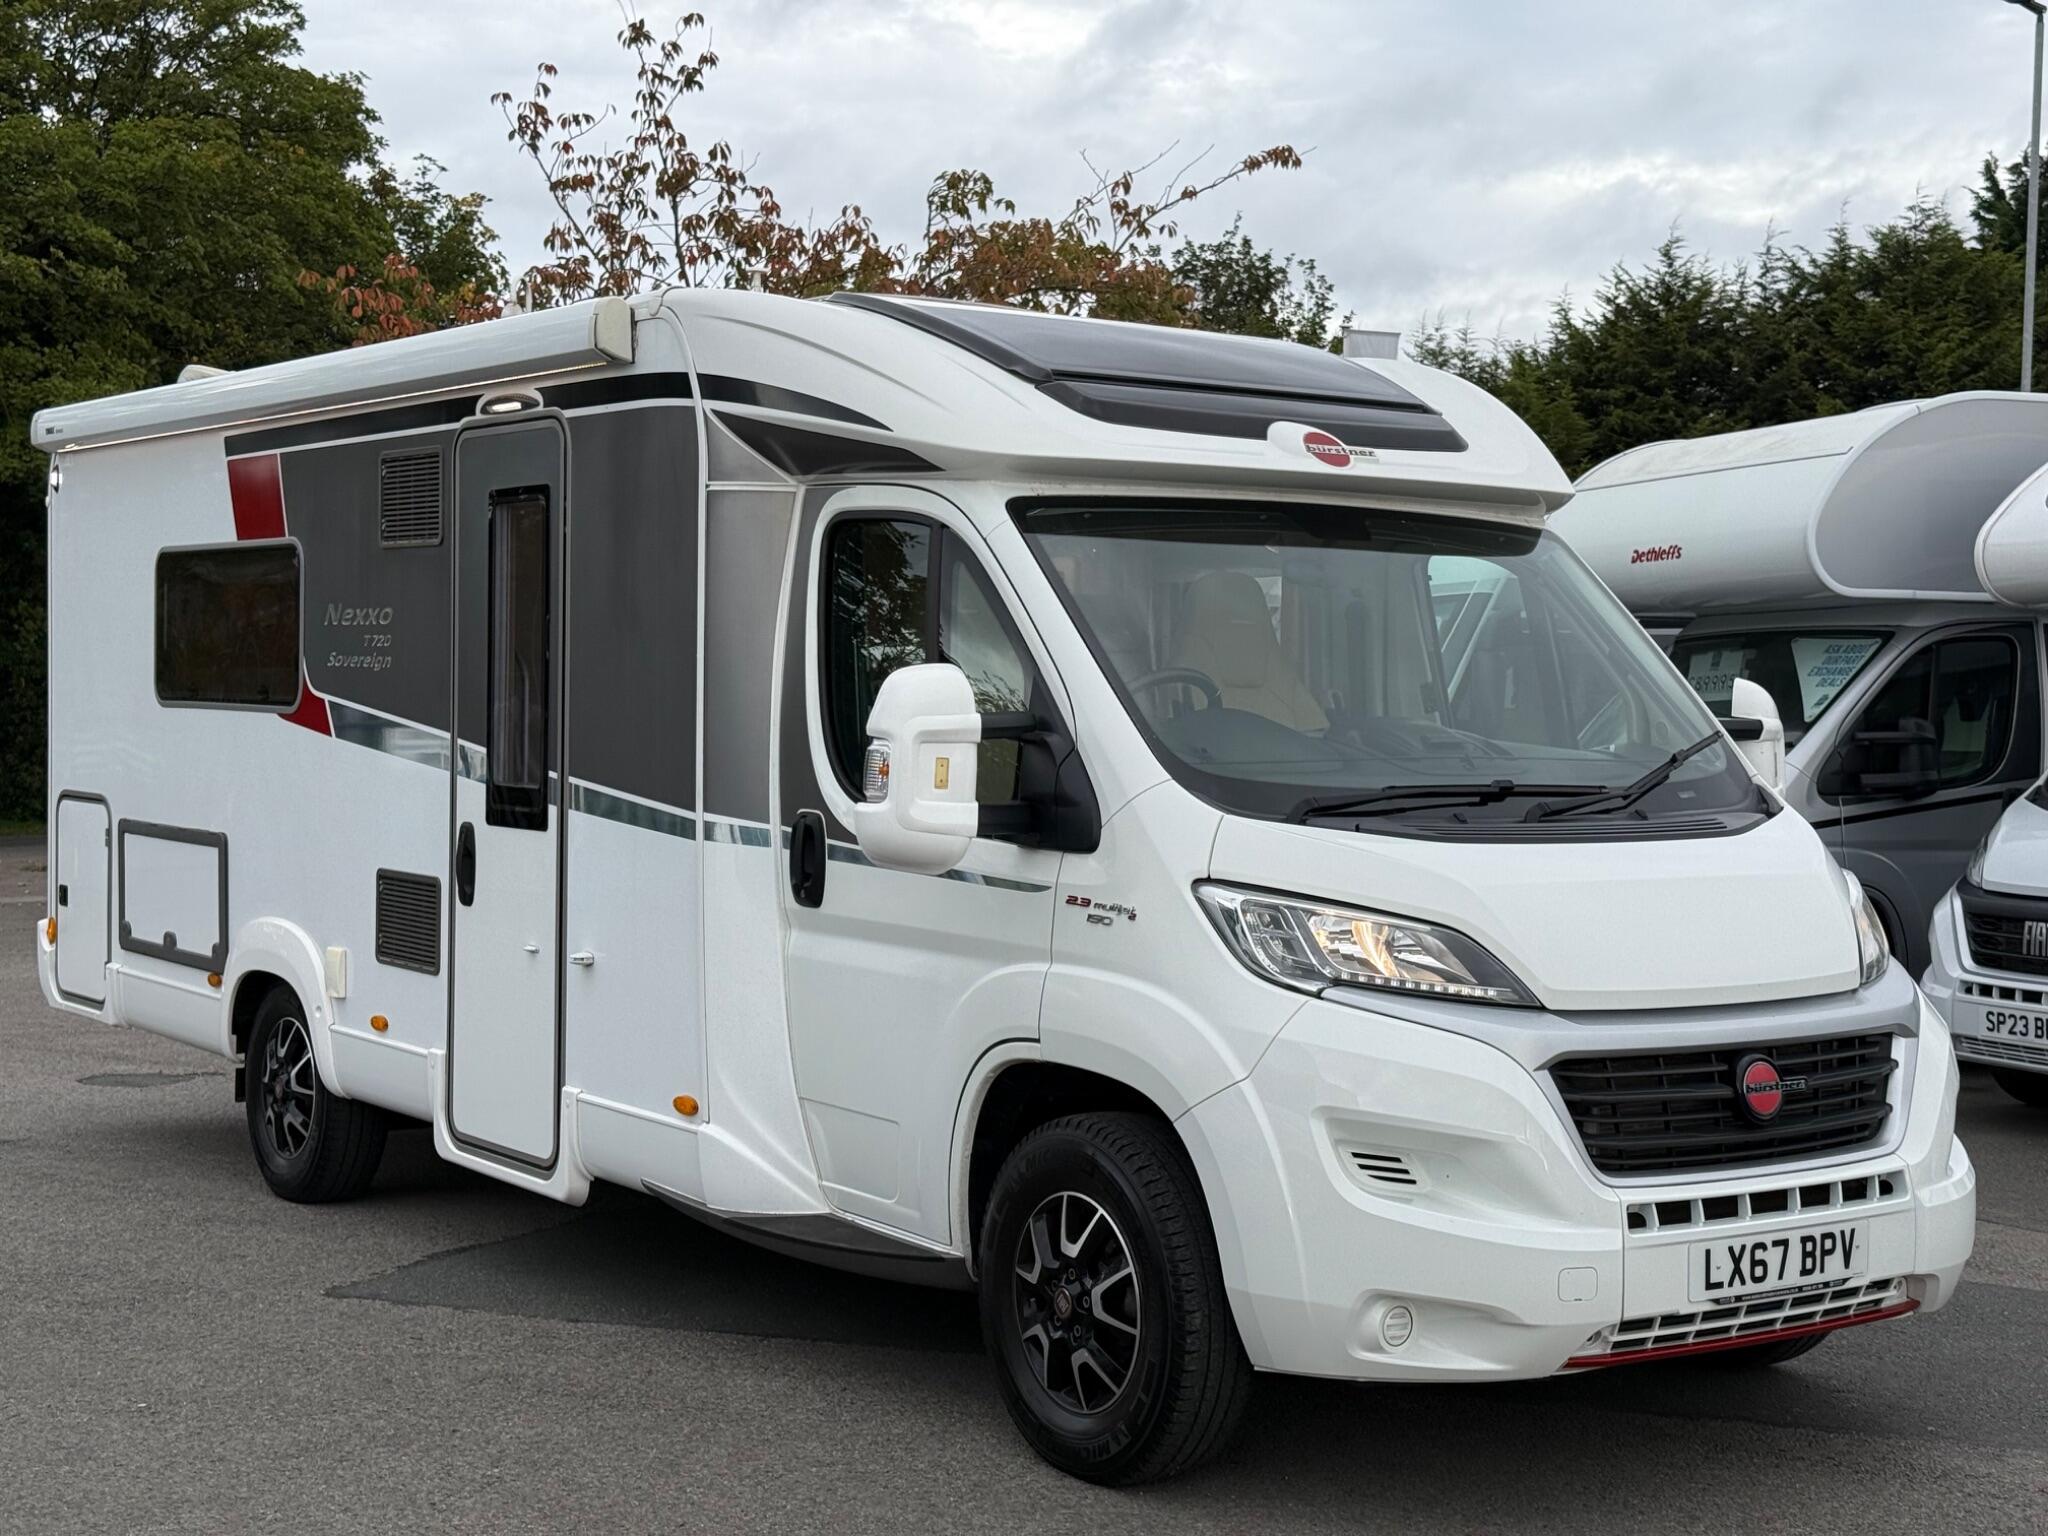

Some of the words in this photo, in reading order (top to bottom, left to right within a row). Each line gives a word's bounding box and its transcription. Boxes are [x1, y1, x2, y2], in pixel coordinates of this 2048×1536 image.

[1305, 444, 1376, 457] bürstner
[1631, 545, 1682, 564] Dethleffs
[324, 603, 393, 626] Nexxo
[327, 652, 392, 671] Sovereign
[2022, 920, 2048, 957] FIA
[1986, 1011, 2029, 1037] SP23
[2034, 1016, 2048, 1040] B
[1704, 1237, 1790, 1291] LX67
[1799, 1227, 1856, 1278] BPV
